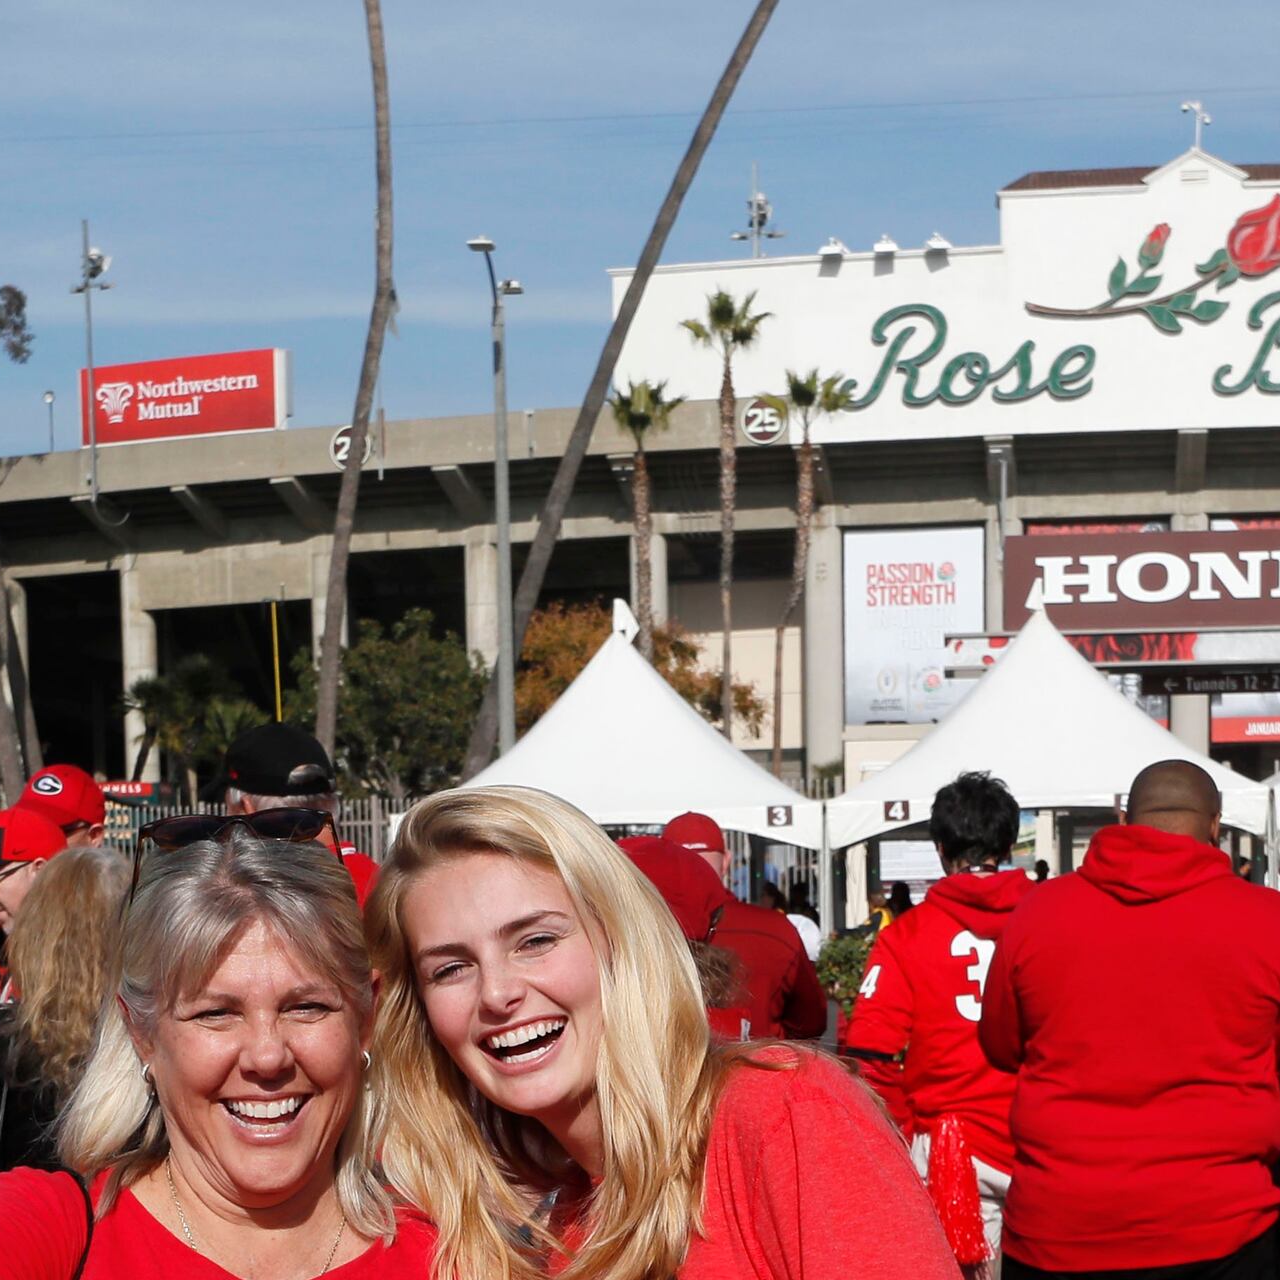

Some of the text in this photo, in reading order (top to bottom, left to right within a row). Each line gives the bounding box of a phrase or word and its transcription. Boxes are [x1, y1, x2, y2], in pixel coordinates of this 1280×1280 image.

[841, 303, 1096, 409] Rose
[136, 374, 259, 400] Northwestern
[137, 398, 201, 421] Mutual
[746, 407, 781, 433] 25
[866, 563, 934, 584] PASSION
[866, 583, 956, 607] STRENGTH
[1185, 675, 1238, 691] Tunnels
[1243, 675, 1260, 690] 12
[772, 807, 787, 825] 3
[888, 802, 905, 820] 4
[859, 964, 882, 999] 4
[950, 930, 996, 1022] 3
